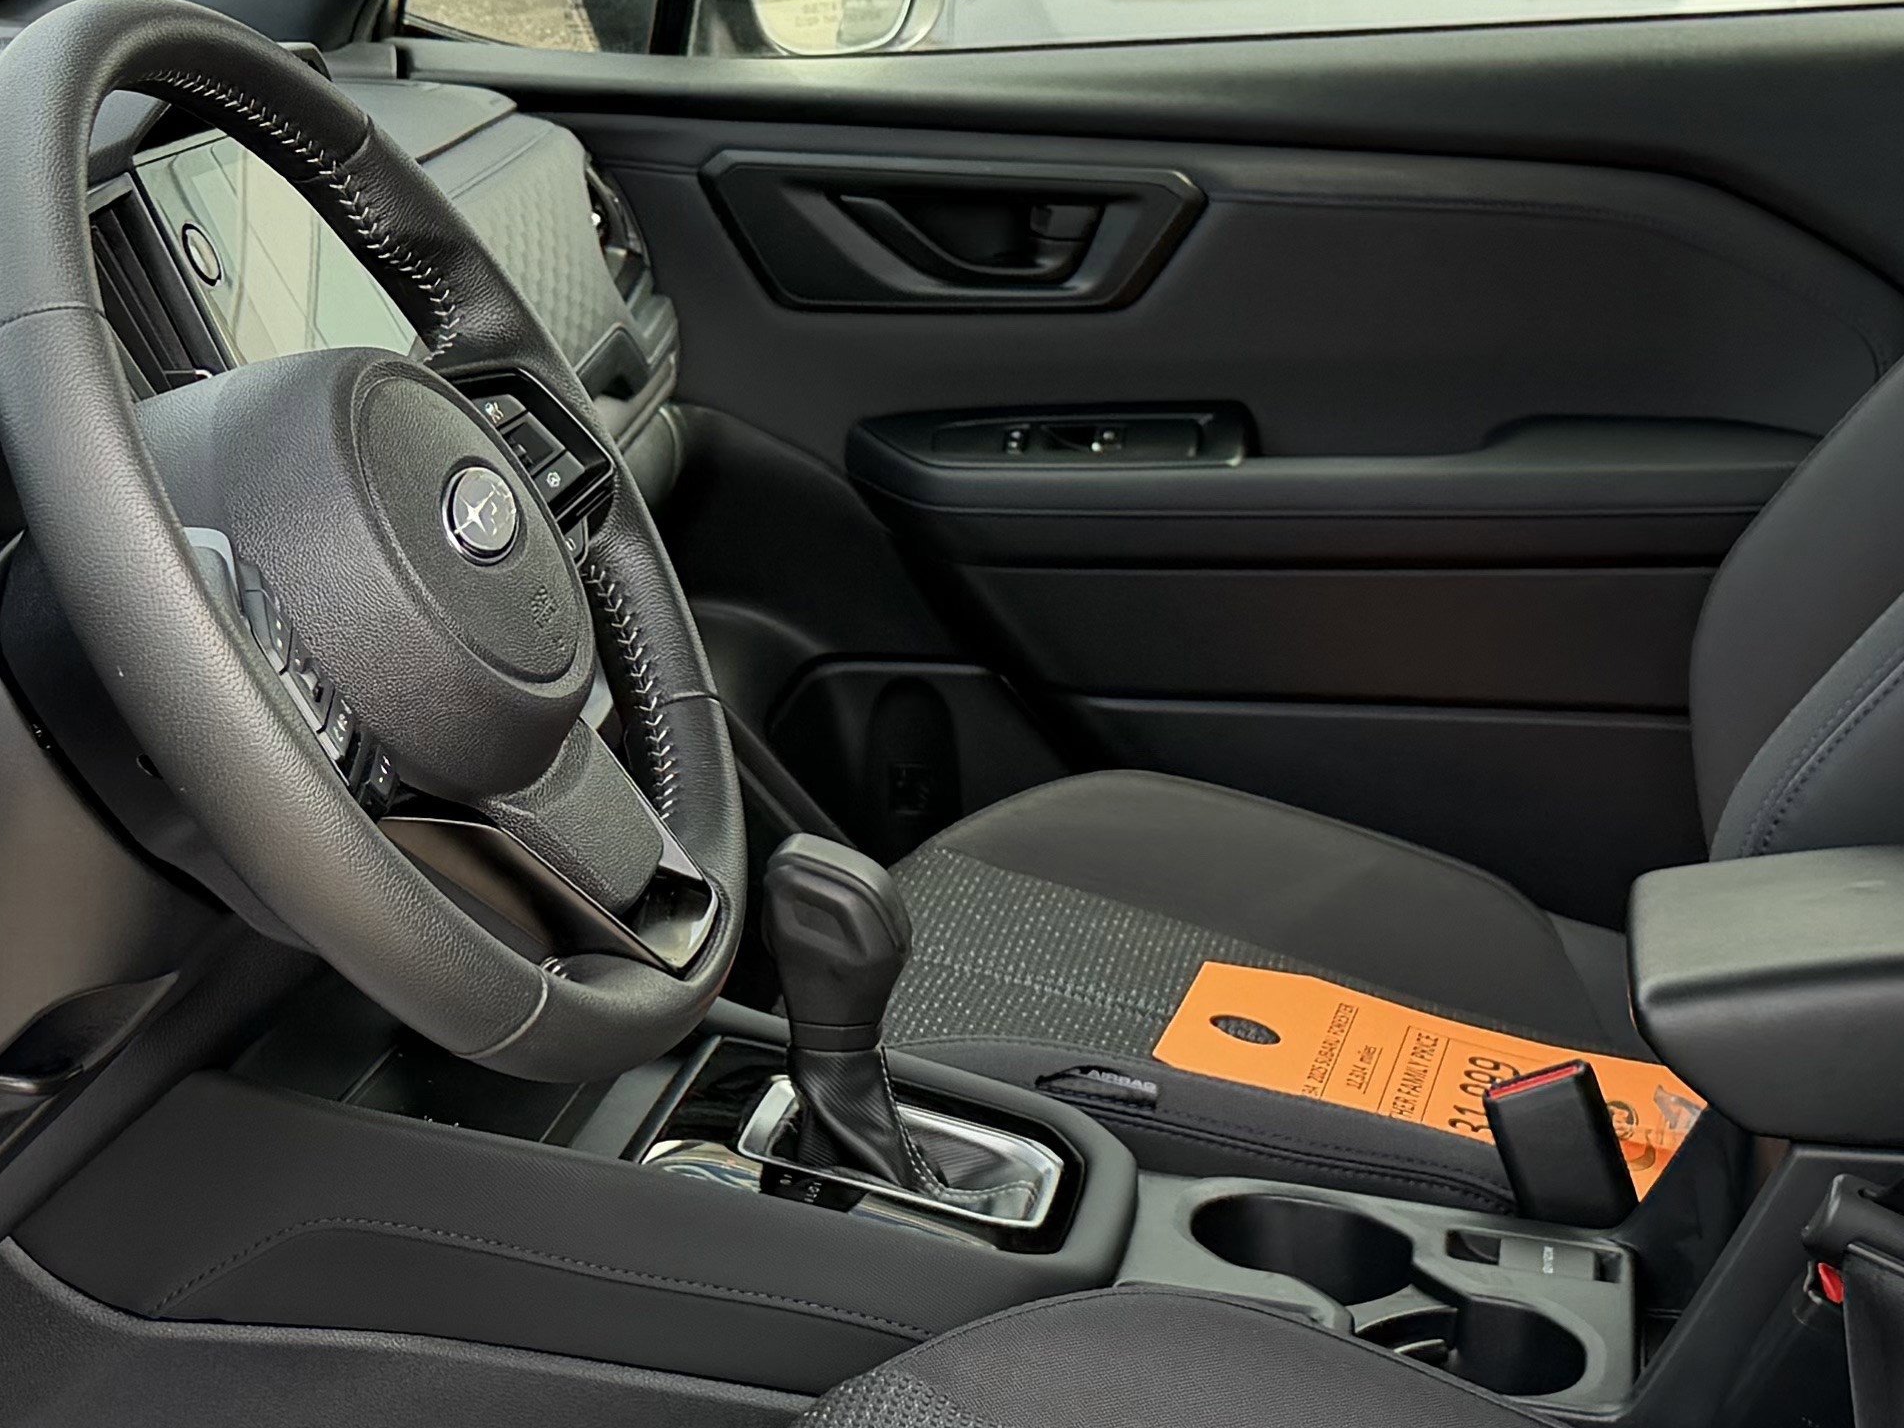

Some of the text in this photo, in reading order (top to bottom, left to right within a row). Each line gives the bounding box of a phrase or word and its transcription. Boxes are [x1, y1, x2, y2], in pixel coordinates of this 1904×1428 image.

[1327, 1002, 1354, 1035] FORESTER
[1314, 1038, 1341, 1066] SUBARU
[1411, 1032, 1438, 1062] PRICE
[1397, 1060, 1429, 1098] FAMILY
